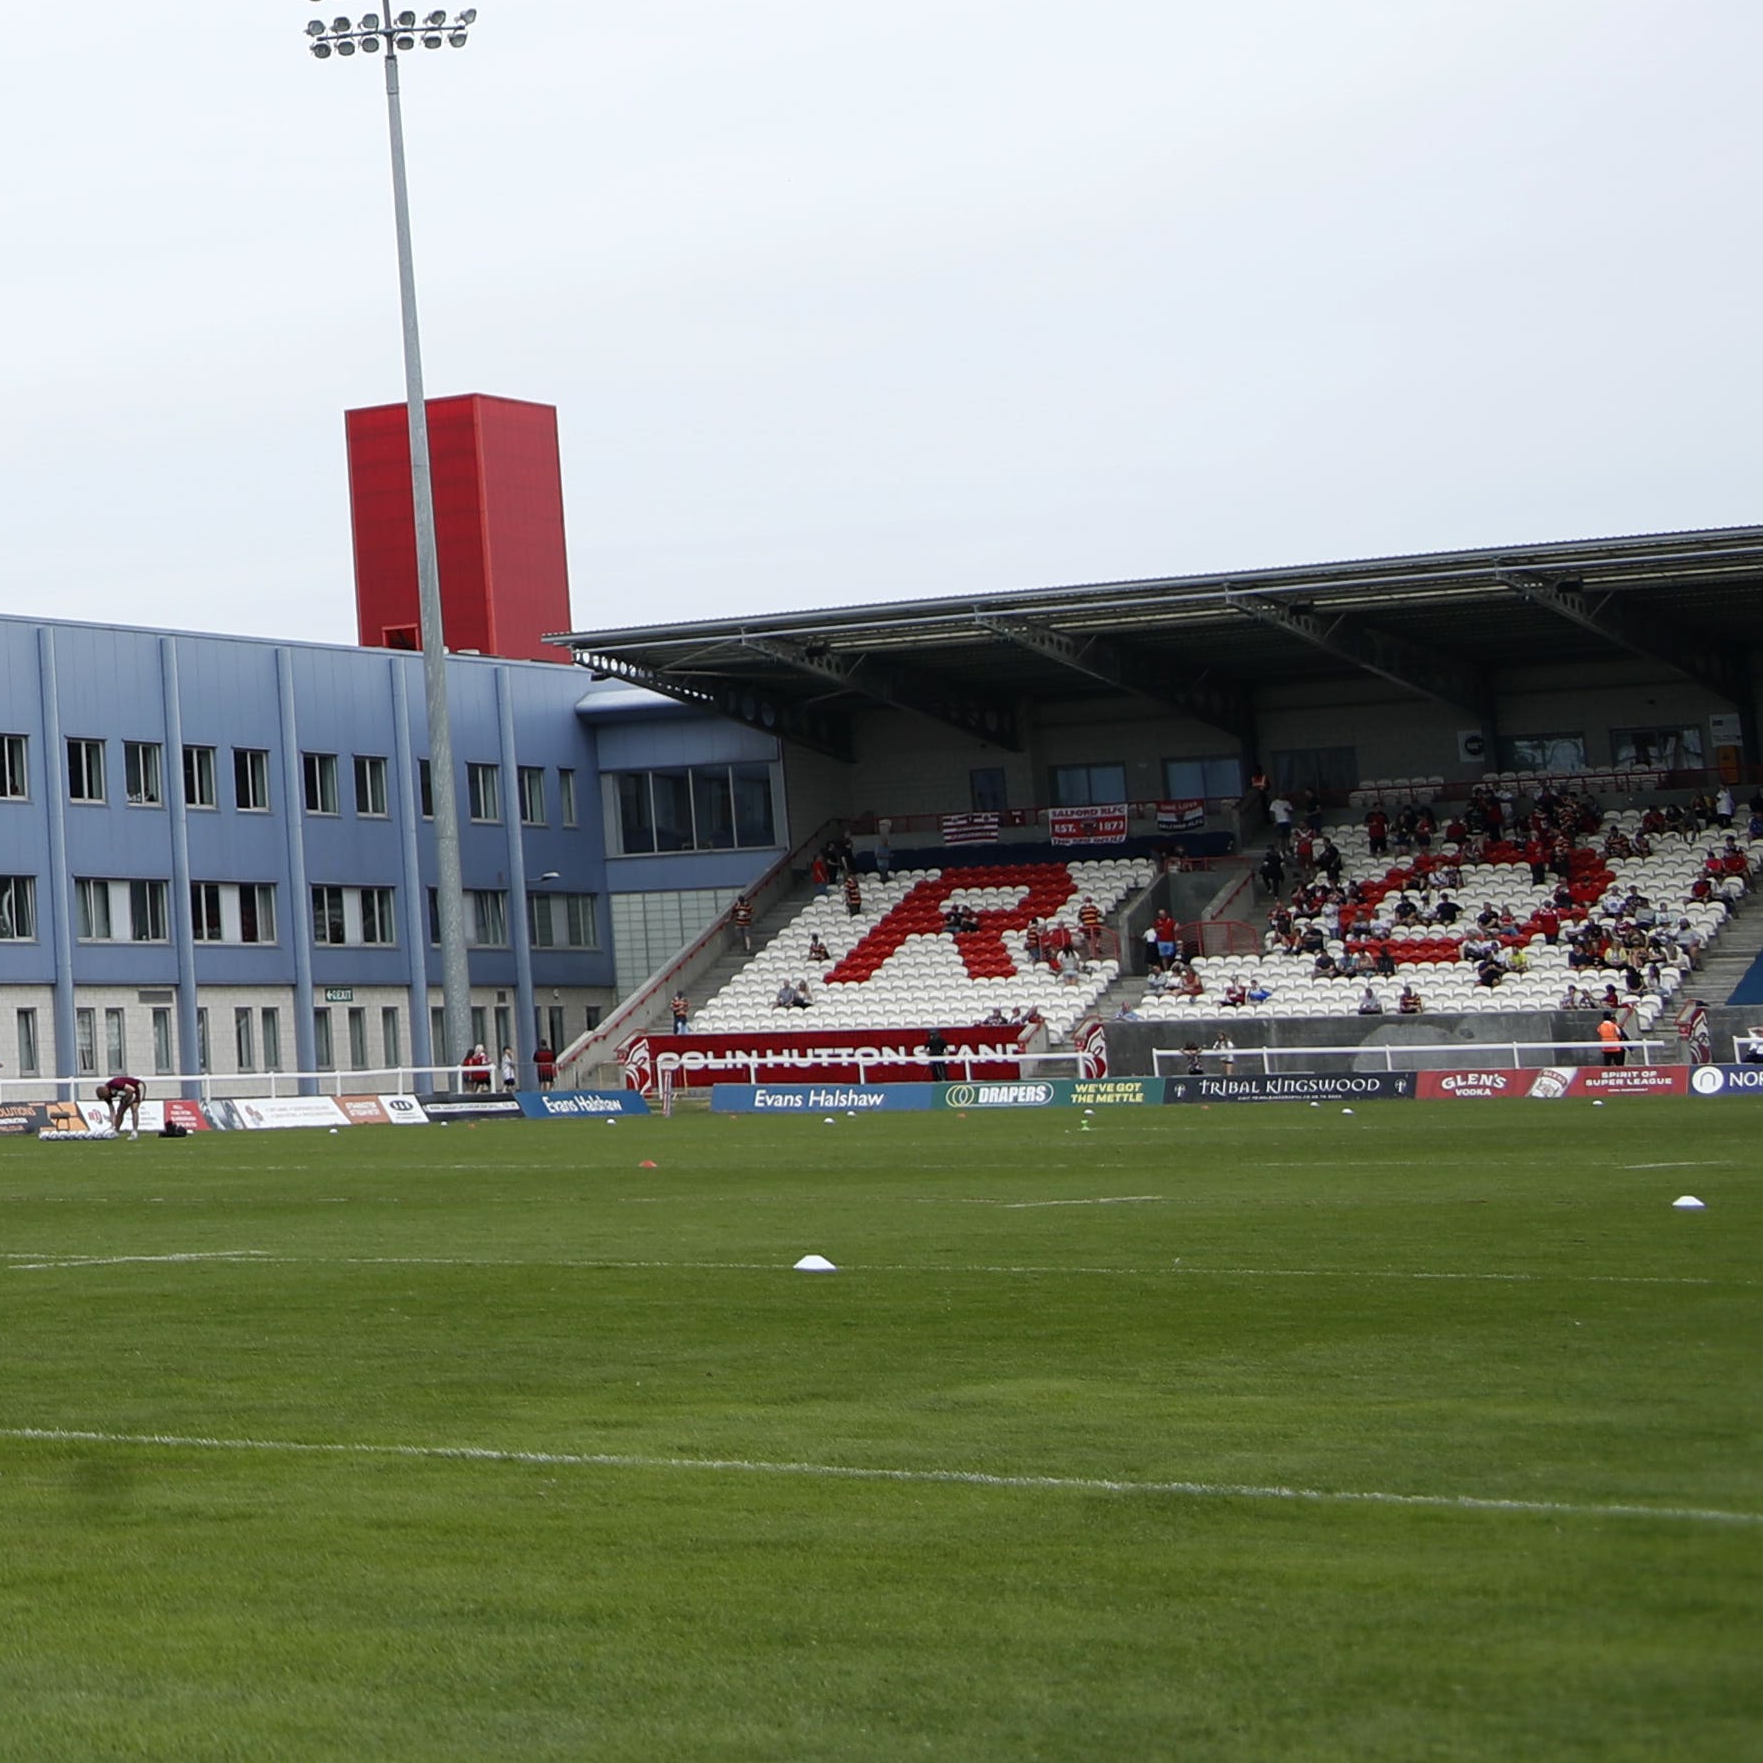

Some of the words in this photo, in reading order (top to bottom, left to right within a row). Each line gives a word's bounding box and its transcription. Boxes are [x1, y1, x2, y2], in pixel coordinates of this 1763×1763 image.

[1052, 808, 1098, 818] SALFORD
[1601, 1071, 1639, 1079] SPIRIT
[1640, 1070, 1658, 1078] OF
[1199, 1078, 1260, 1095] TRIBAL
[1266, 1077, 1381, 1094] KINGSWOOD
[1441, 1073, 1507, 1091] GLEN'S
[1585, 1078, 1625, 1086] SUPER
[1626, 1077, 1673, 1085] LEAGUE
[1075, 1082, 1113, 1094] WE'VE
[1116, 1082, 1142, 1093] GOT
[1455, 1088, 1492, 1097] VODKA
[753, 1089, 803, 1108] Evans
[809, 1088, 885, 1108] Halshaw
[978, 1085, 1046, 1104] DRAPERS
[1071, 1093, 1093, 1104] THE
[1094, 1092, 1144, 1103] METTLE
[543, 1096, 574, 1113] Evans
[575, 1095, 623, 1112] Halshaw
